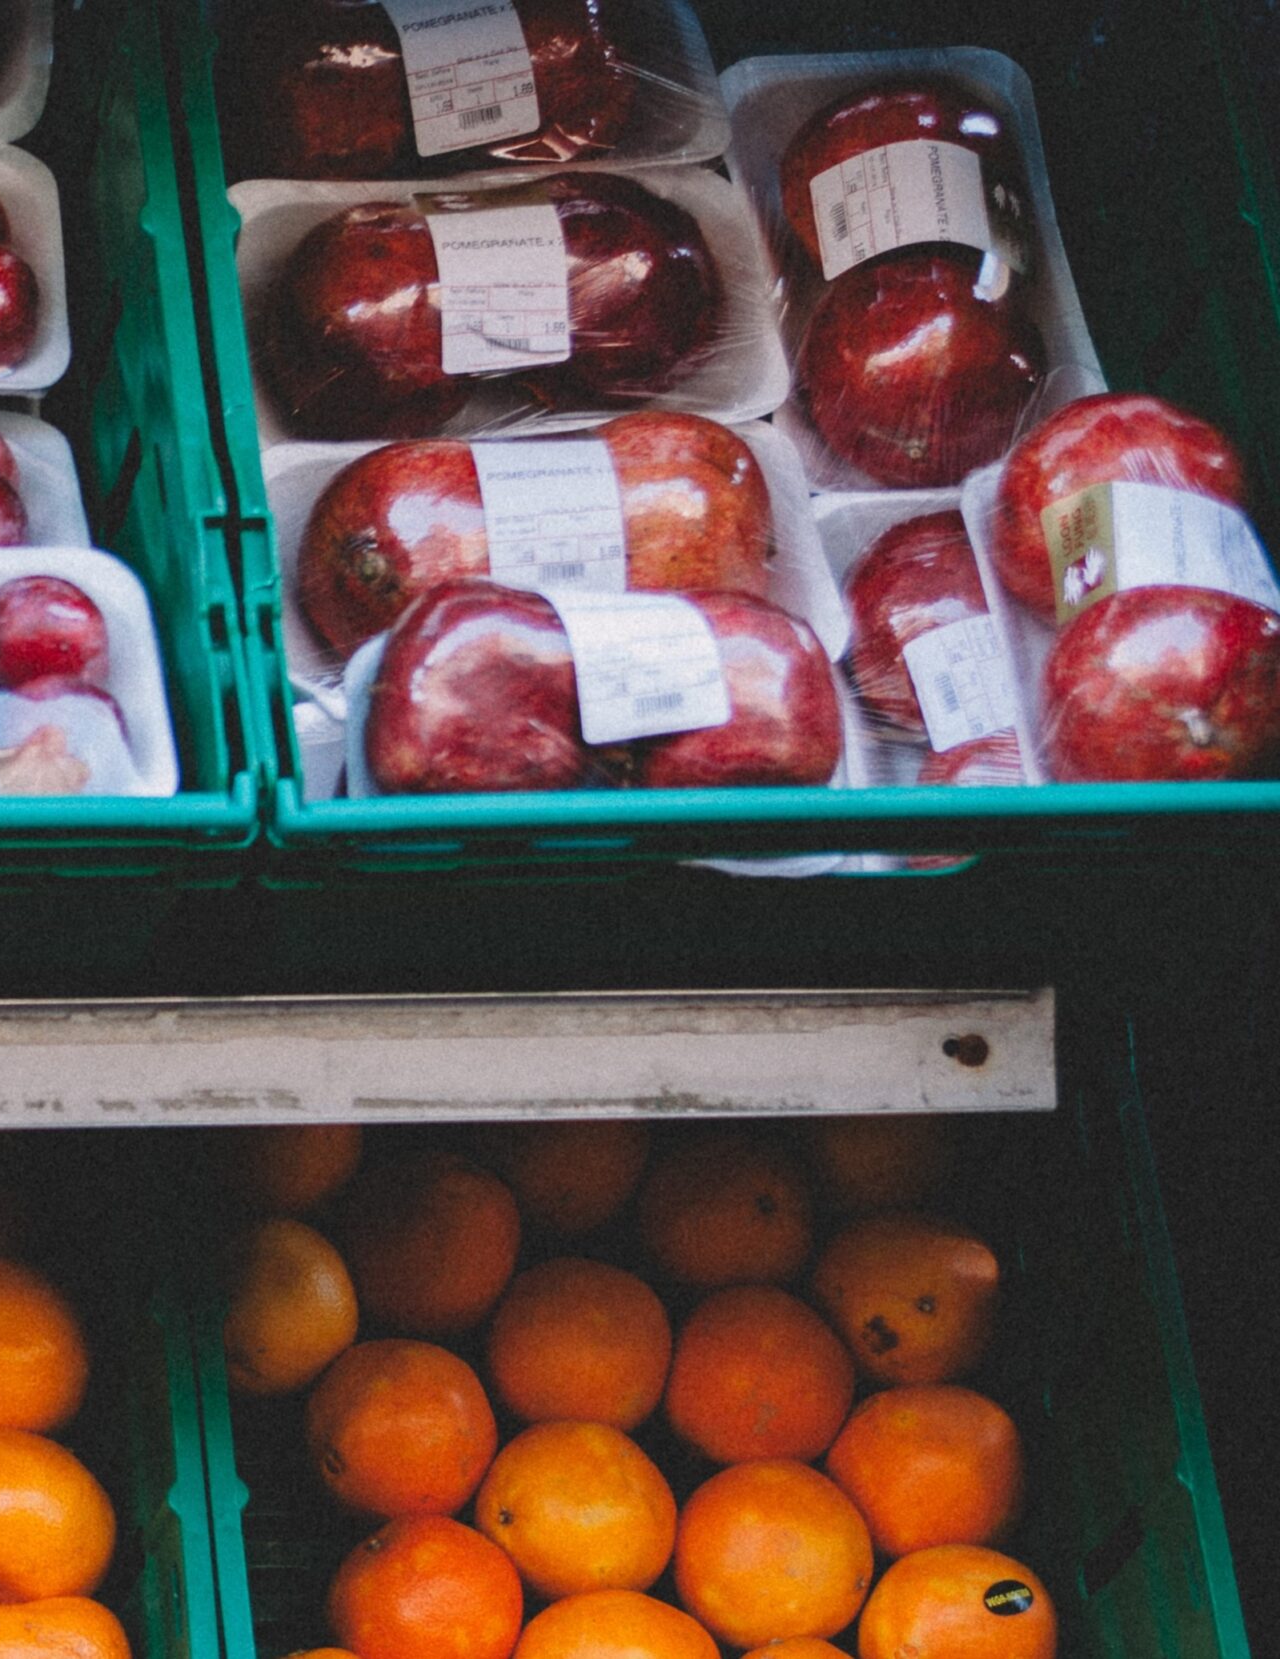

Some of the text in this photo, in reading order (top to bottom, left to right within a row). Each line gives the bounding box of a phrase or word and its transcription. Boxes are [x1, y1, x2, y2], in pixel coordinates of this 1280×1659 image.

[402, 6, 498, 33] POMEGRANATE
[927, 144, 947, 225] POMEGRANATE
[442, 237, 545, 250] POMEGRANATE
